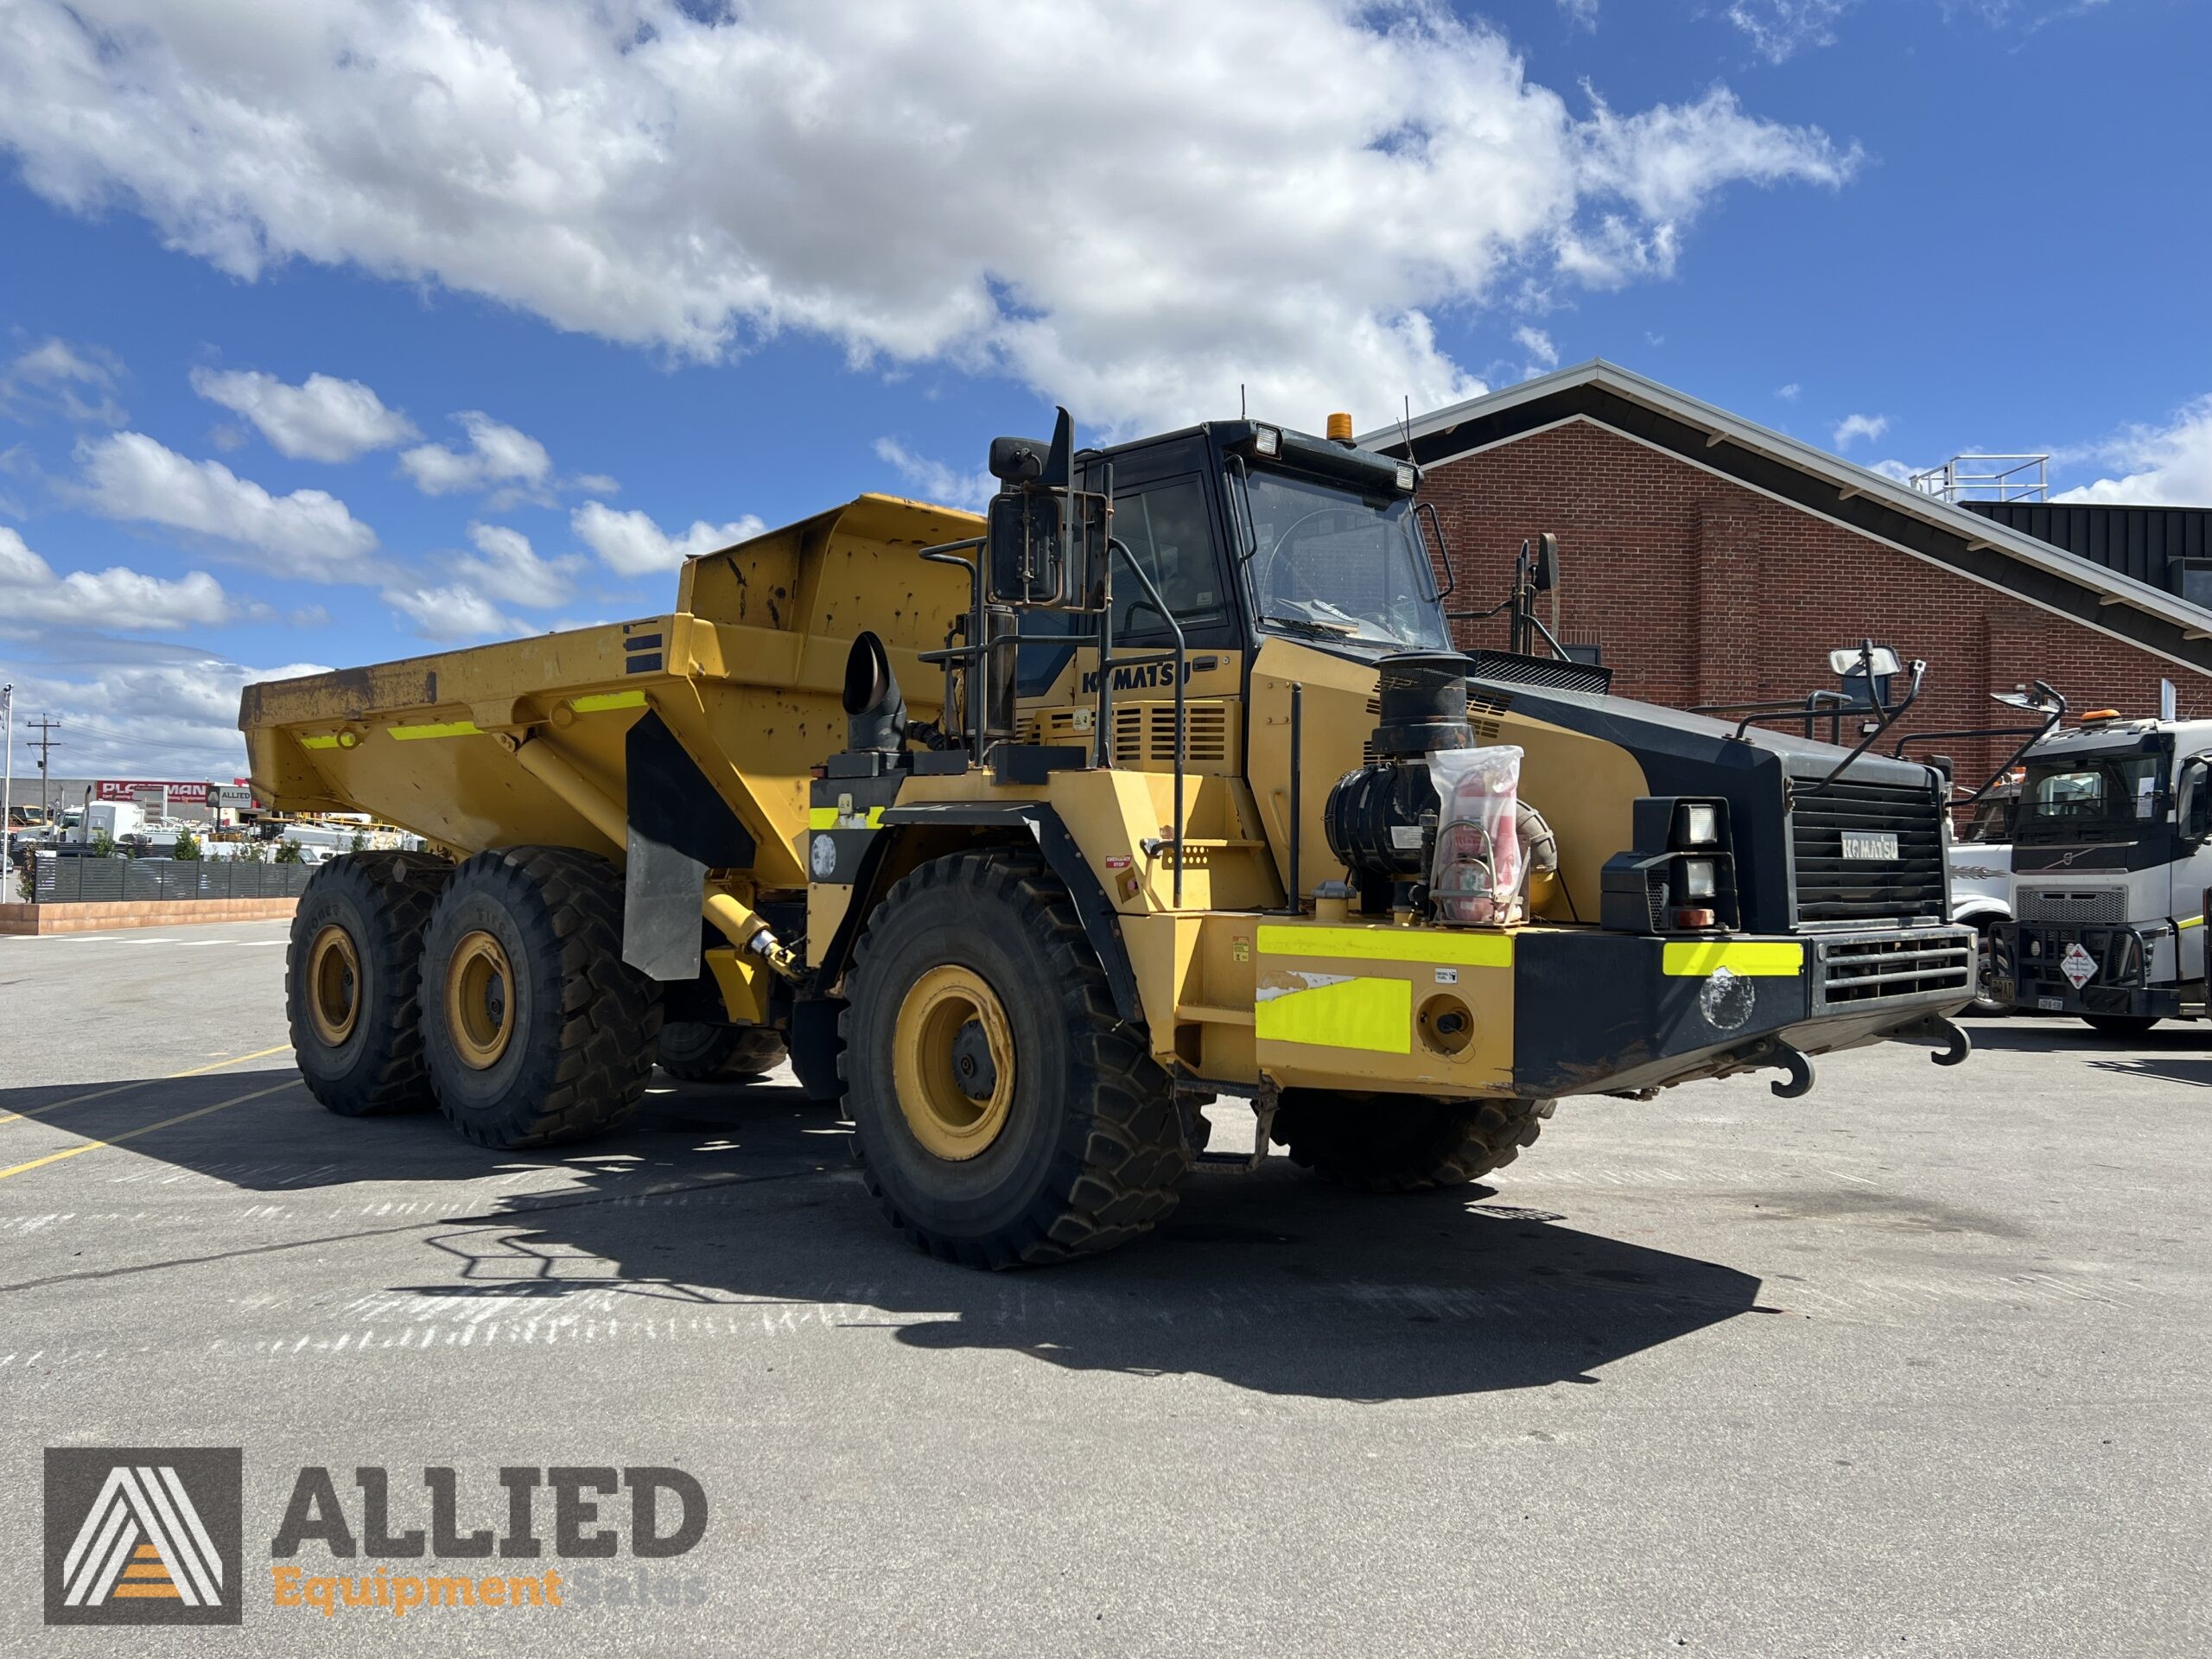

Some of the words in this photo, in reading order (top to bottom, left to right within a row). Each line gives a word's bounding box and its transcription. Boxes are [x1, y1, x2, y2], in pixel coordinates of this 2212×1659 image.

[1082, 662, 1191, 693] KMATS
[103, 783, 206, 795] PLAMAN
[221, 791, 251, 800] ALLIED
[1842, 835, 1898, 859] KOMATSU
